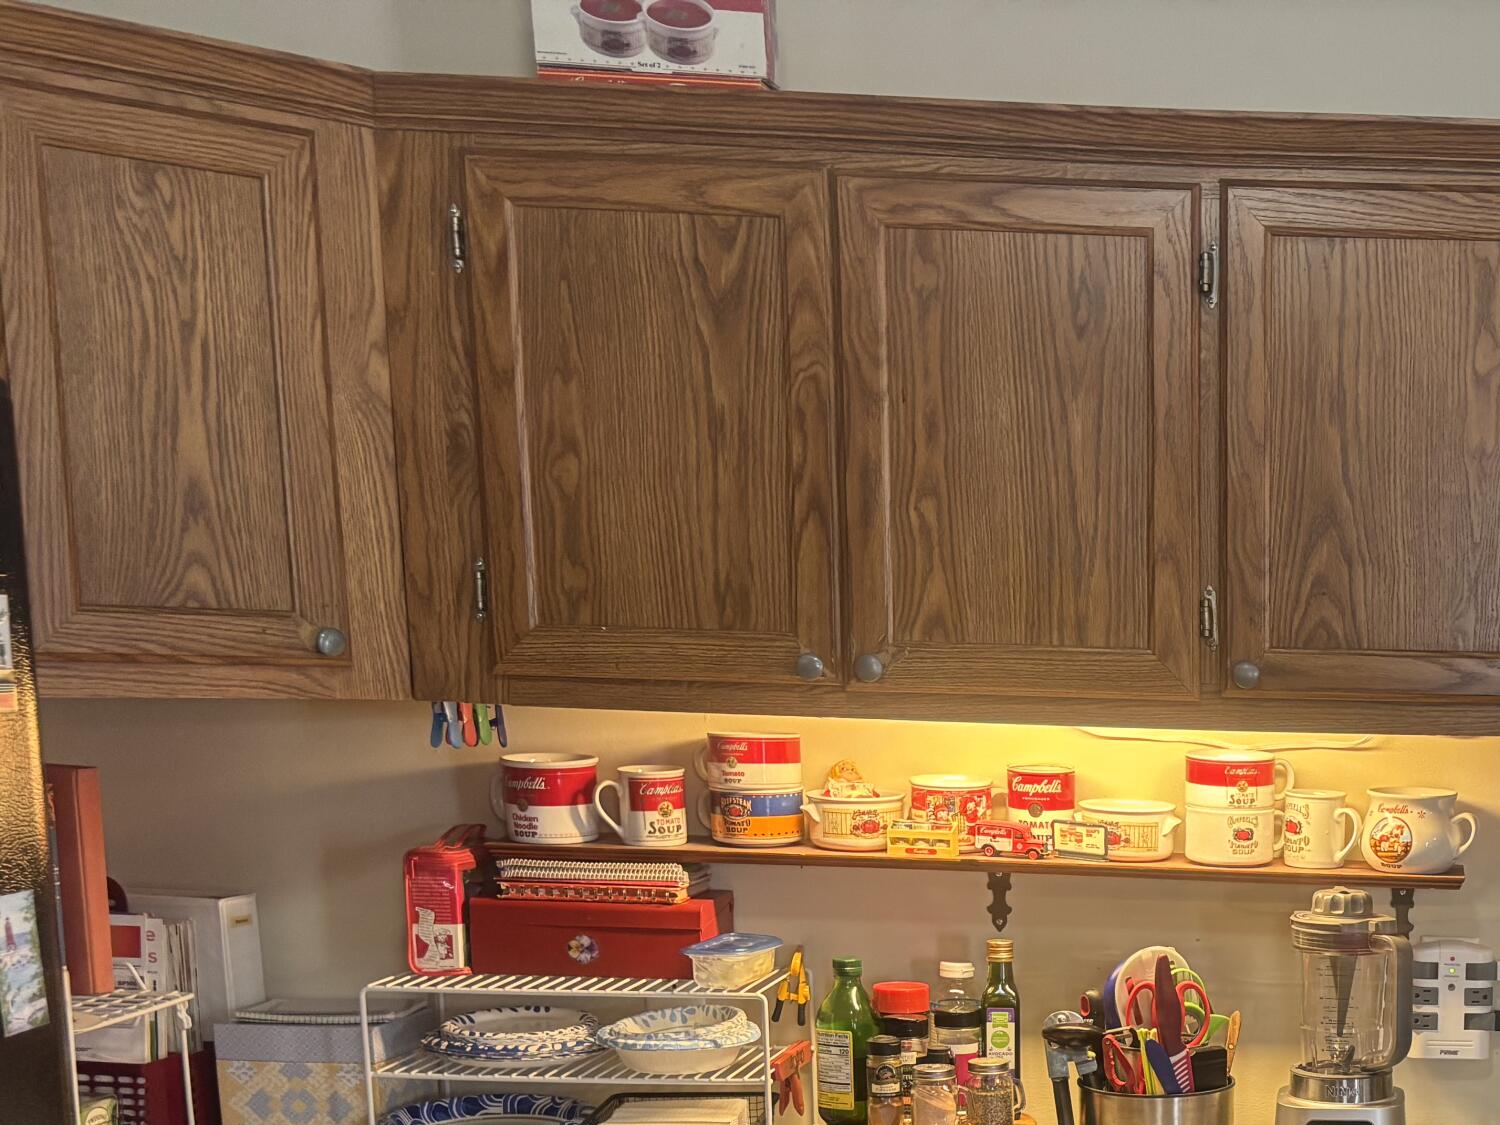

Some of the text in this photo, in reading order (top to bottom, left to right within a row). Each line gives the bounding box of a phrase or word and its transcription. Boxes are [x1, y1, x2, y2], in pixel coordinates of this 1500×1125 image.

[1012, 776, 1062, 796] Campbell's
[1228, 794, 1256, 805] SOUP
[512, 813, 538, 822] Chicken
[656, 818, 681, 826] TOMATO
[513, 821, 538, 831] Noodle
[647, 821, 682, 835] SOUP
[514, 830, 538, 838] SOUP
